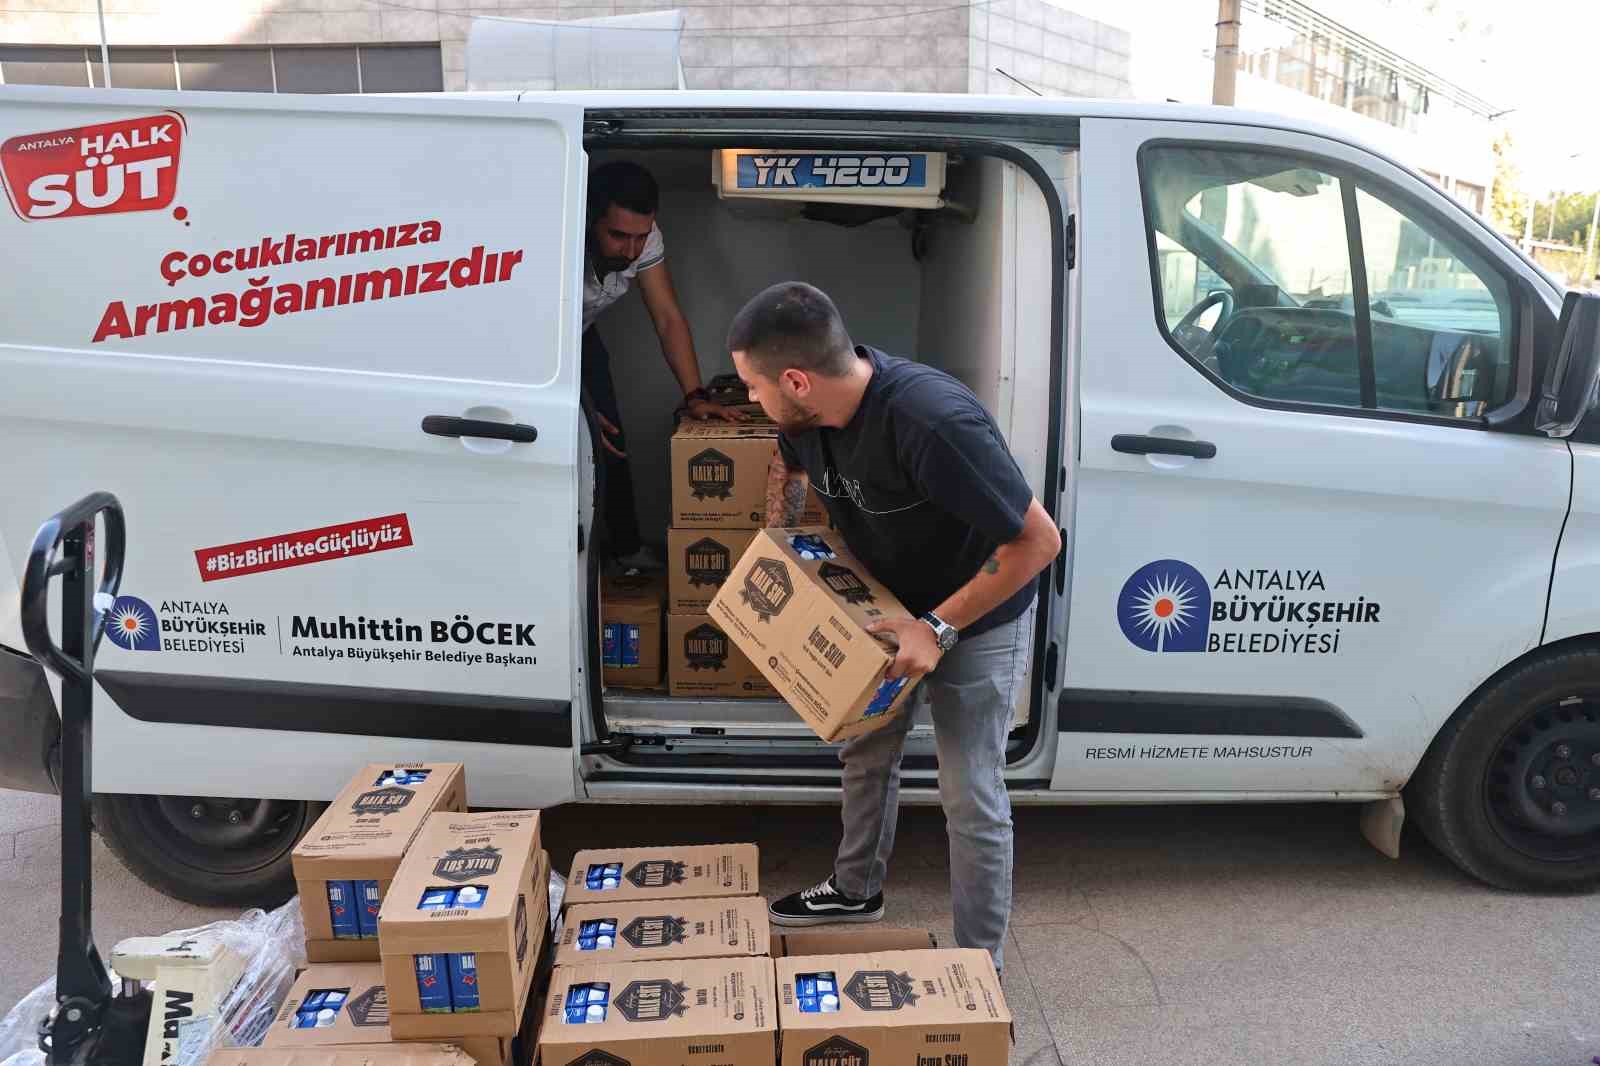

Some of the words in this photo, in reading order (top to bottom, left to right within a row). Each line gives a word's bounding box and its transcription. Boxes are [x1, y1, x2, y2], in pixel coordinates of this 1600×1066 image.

[17, 135, 75, 152] ANTALYA
[81, 123, 173, 156] HALK
[753, 157, 800, 185] YK
[812, 157, 911, 185] 4200
[27, 154, 172, 217] SÜT
[160, 220, 442, 286] Çocuklarımıza
[92, 245, 523, 343] Armağanımızdır
[206, 524, 403, 573] #BizBirlikteGüçlüyüz
[1214, 569, 1326, 591] ANTALYA
[160, 600, 229, 616] ANTALYA
[1212, 596, 1380, 628] BÜYÜKŞEHİR
[161, 613, 266, 637] BÜYÜKŞEHİR
[291, 615, 422, 642] Muhittin
[430, 615, 536, 646] BÖCEK
[164, 635, 245, 653] BELEDİYESİ
[1208, 628, 1340, 653] BELEDİYESİ
[292, 645, 344, 661] Antalya
[347, 646, 421, 662] Büyükşehir
[425, 650, 482, 665] Belediye
[486, 651, 537, 667] Başkanı
[1085, 745, 1136, 759] RESMİ
[1140, 745, 1208, 759] HİZMETE
[1212, 746, 1312, 759] MAHSUSTUR
[462, 955, 475, 969] HAL
